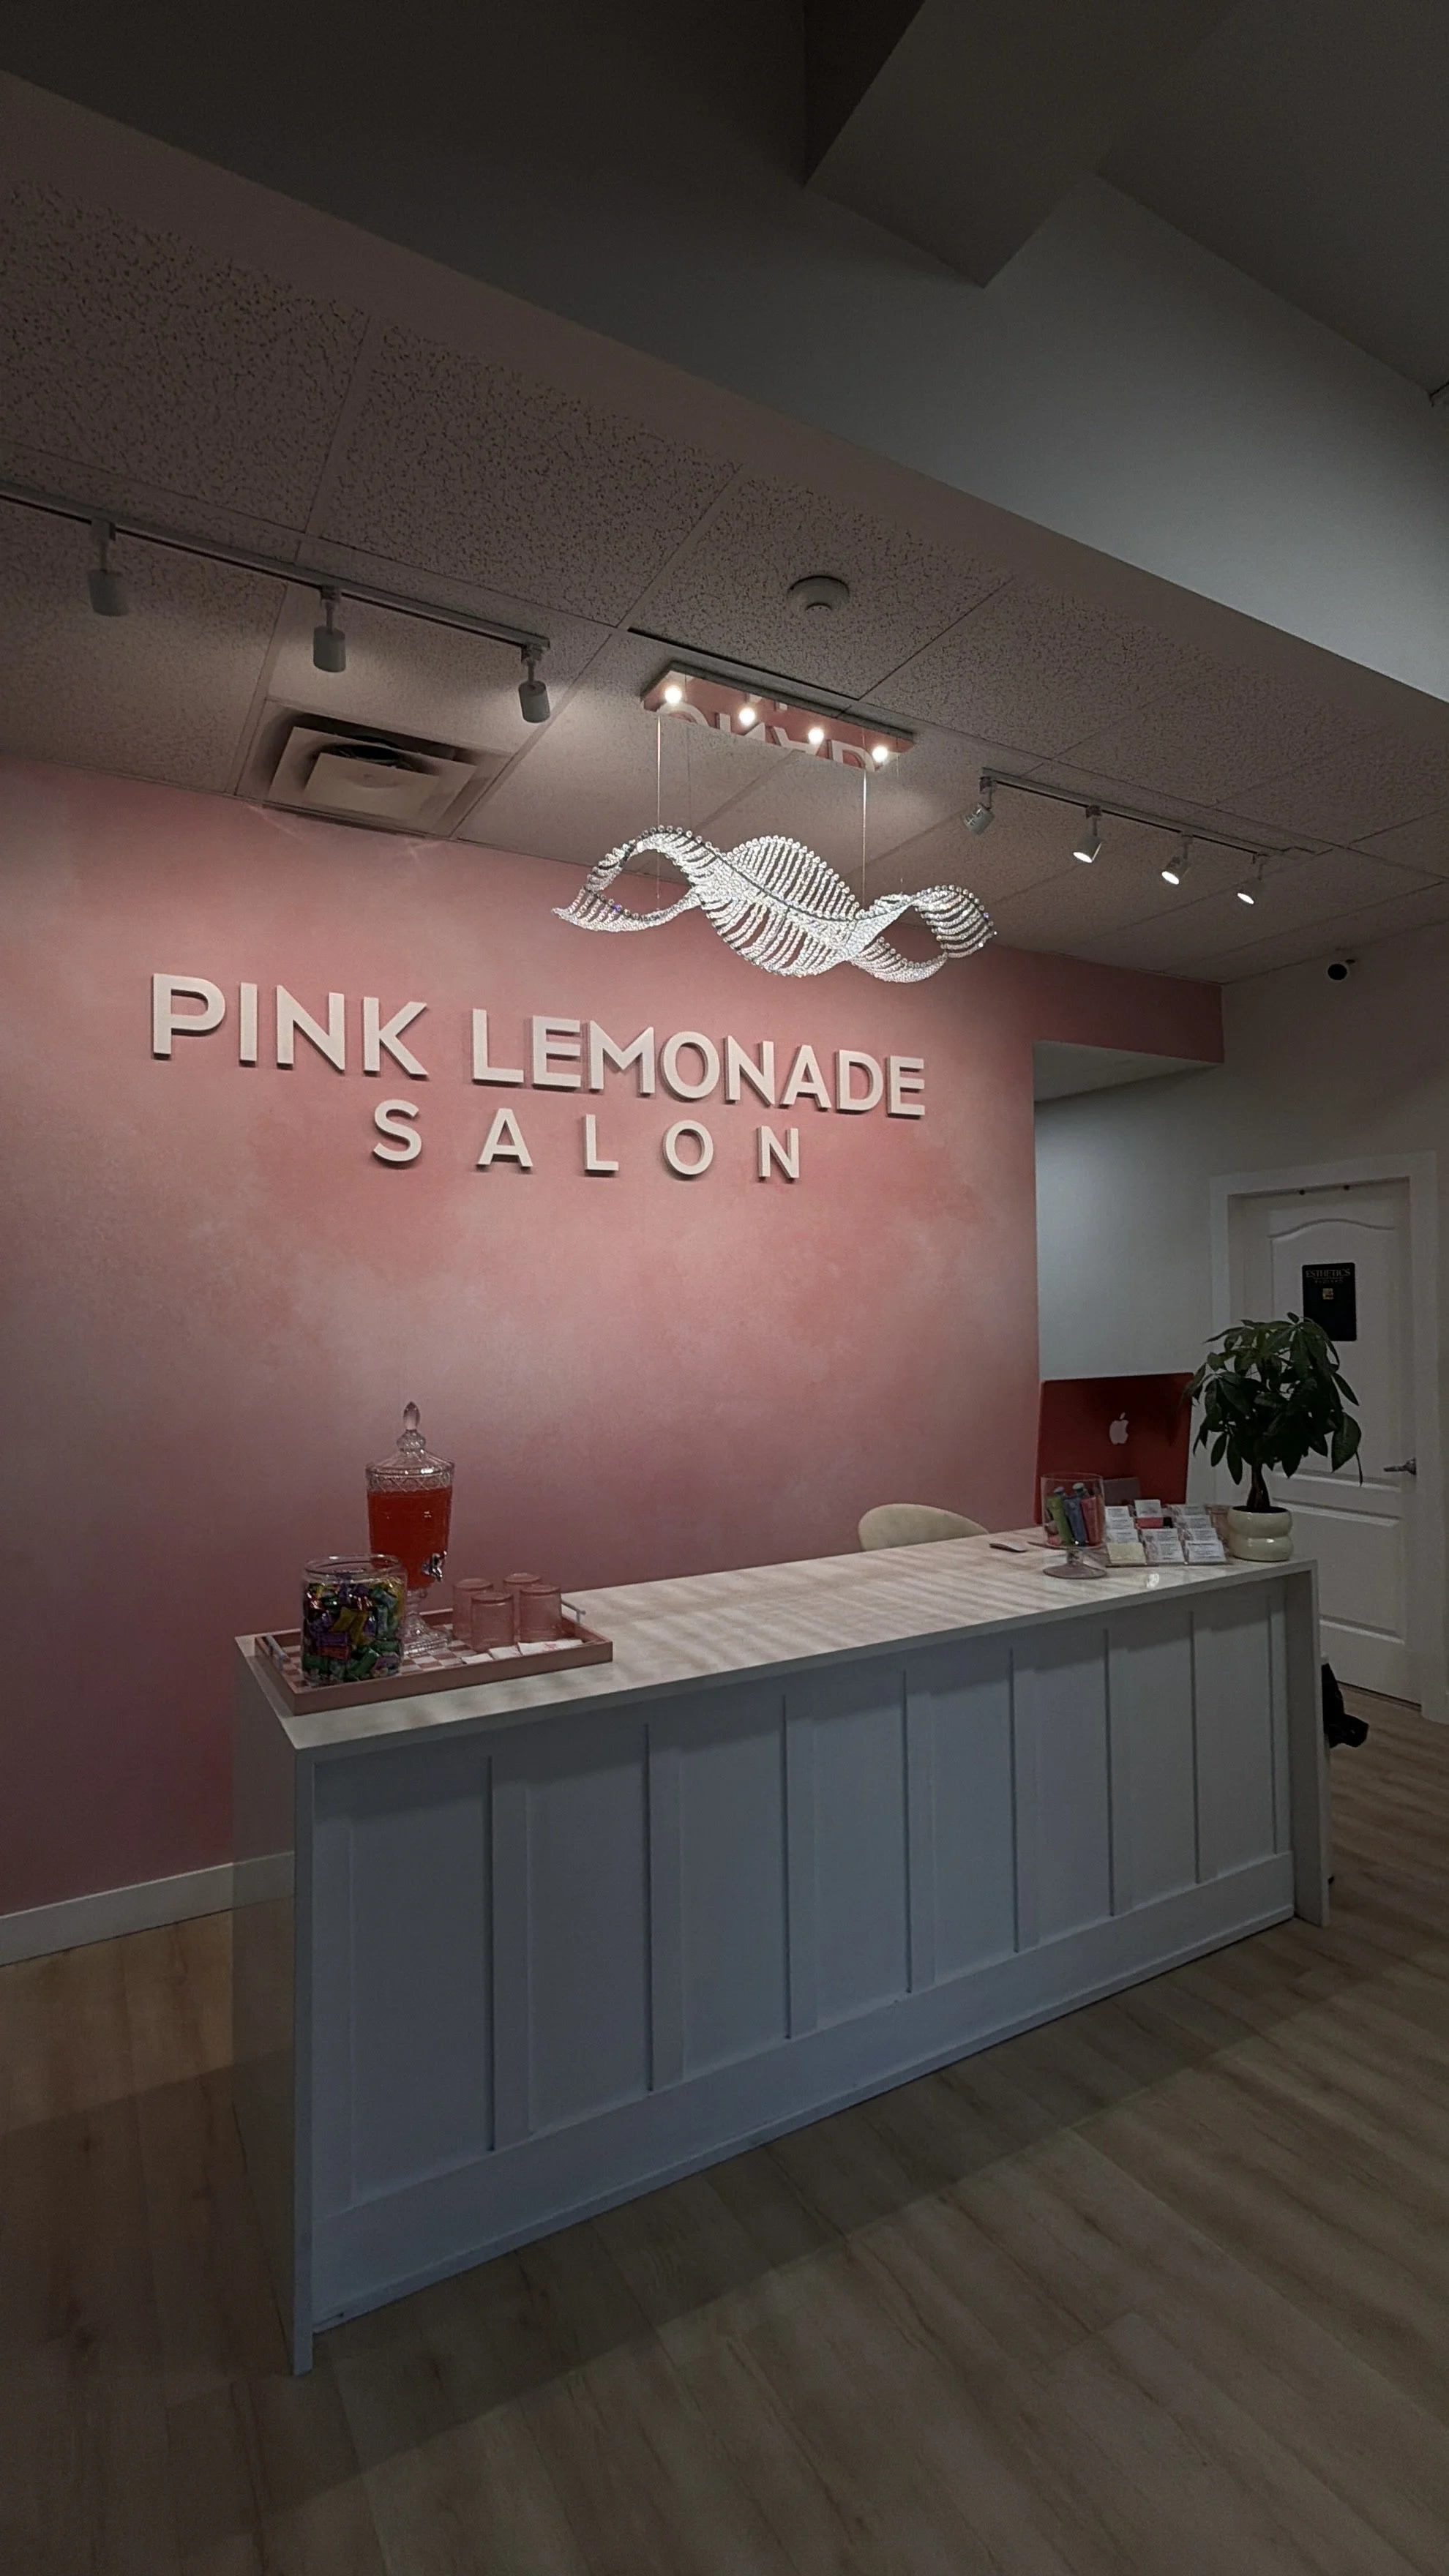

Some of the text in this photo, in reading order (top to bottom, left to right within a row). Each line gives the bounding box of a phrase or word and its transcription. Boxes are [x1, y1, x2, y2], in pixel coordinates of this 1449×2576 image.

[151, 973, 926, 1117] PINK LEMONADE
[372, 1099, 800, 1180] SALON
[1305, 1268, 1351, 1278] ESTHETICS
